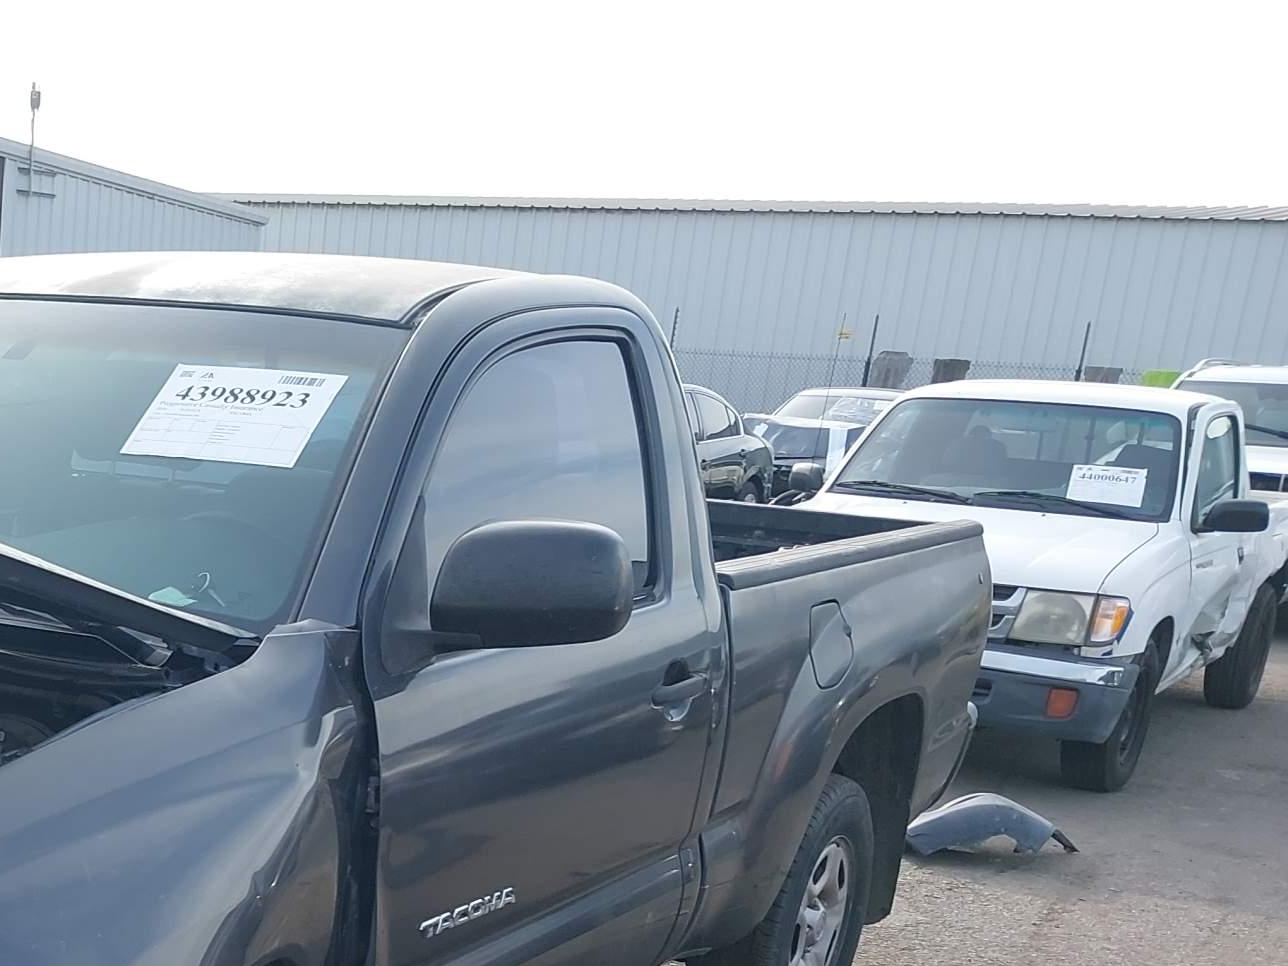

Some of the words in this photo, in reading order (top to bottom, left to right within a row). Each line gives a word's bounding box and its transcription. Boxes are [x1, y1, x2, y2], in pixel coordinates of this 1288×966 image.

[175, 385, 311, 409] 43988923
[1077, 472, 1138, 484] 44000647
[419, 887, 516, 938] TACOMA
